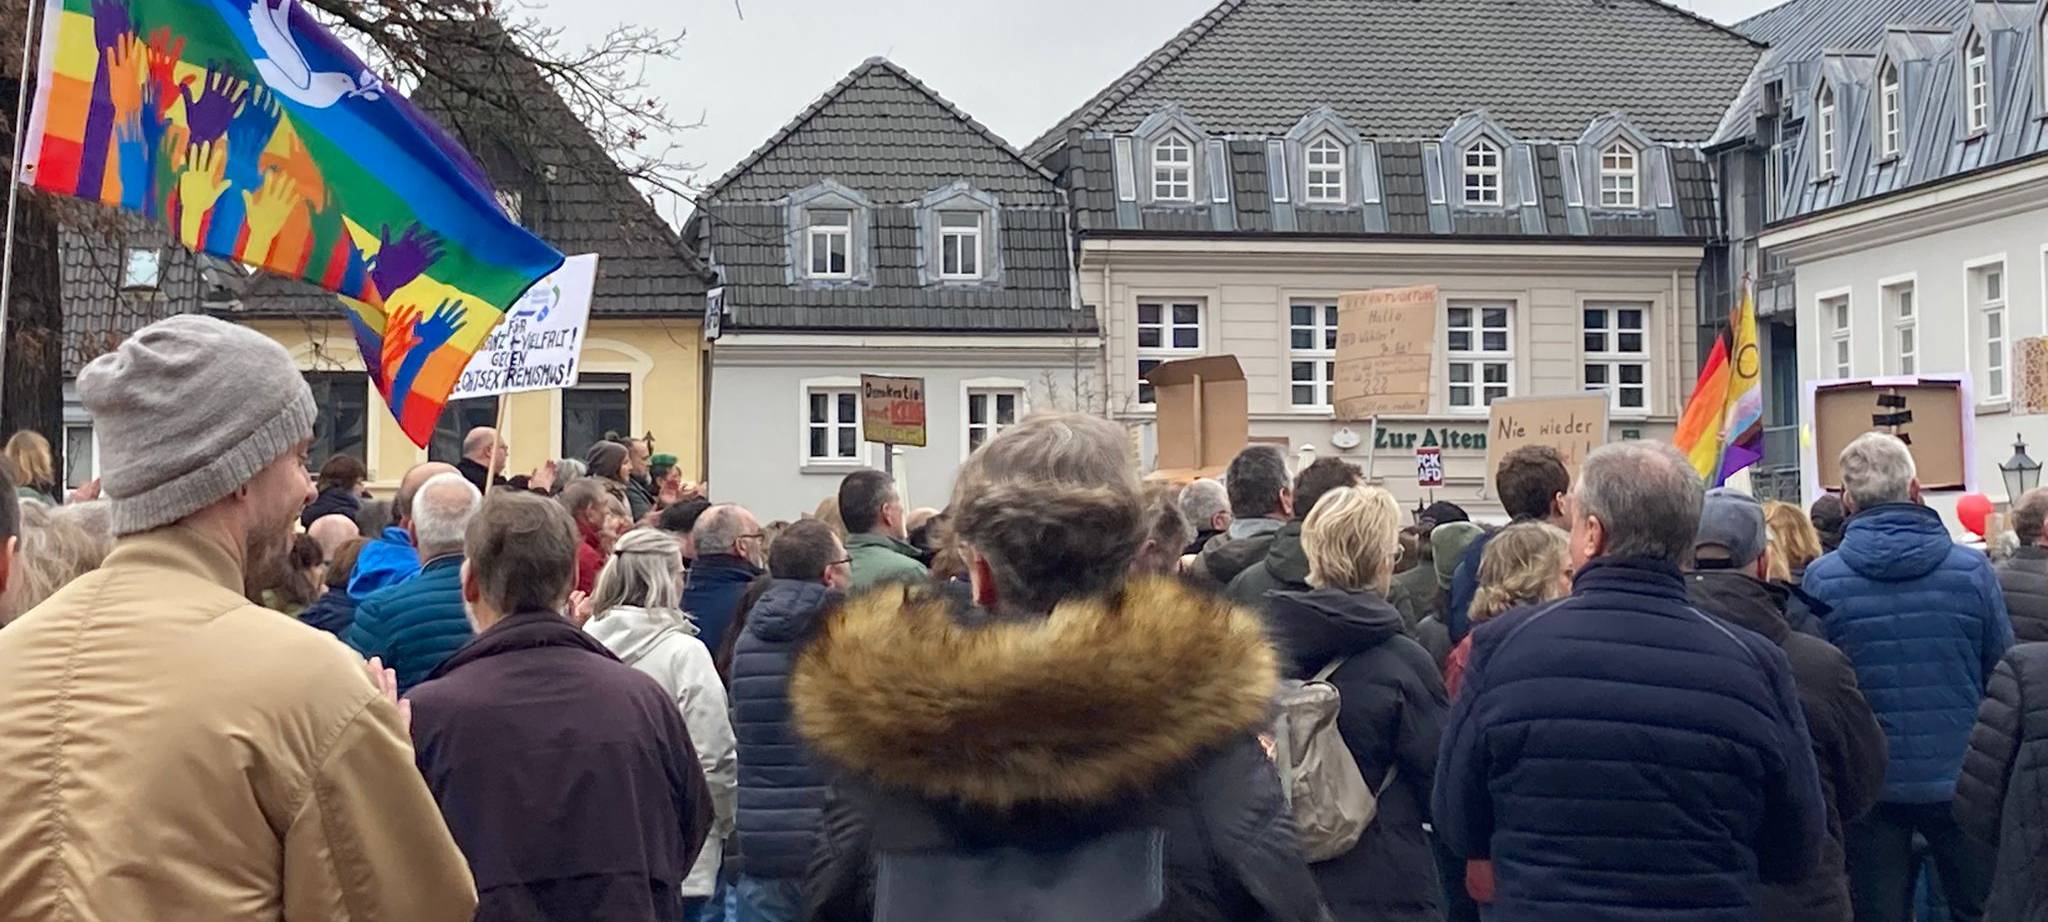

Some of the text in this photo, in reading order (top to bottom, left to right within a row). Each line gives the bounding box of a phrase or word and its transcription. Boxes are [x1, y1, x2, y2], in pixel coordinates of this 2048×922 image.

[1499, 413, 1592, 439] Nie wieder
[1375, 428, 1487, 449] Zur Alten
[1417, 454, 1440, 468] FCK
[1418, 467, 1441, 481] AFD
